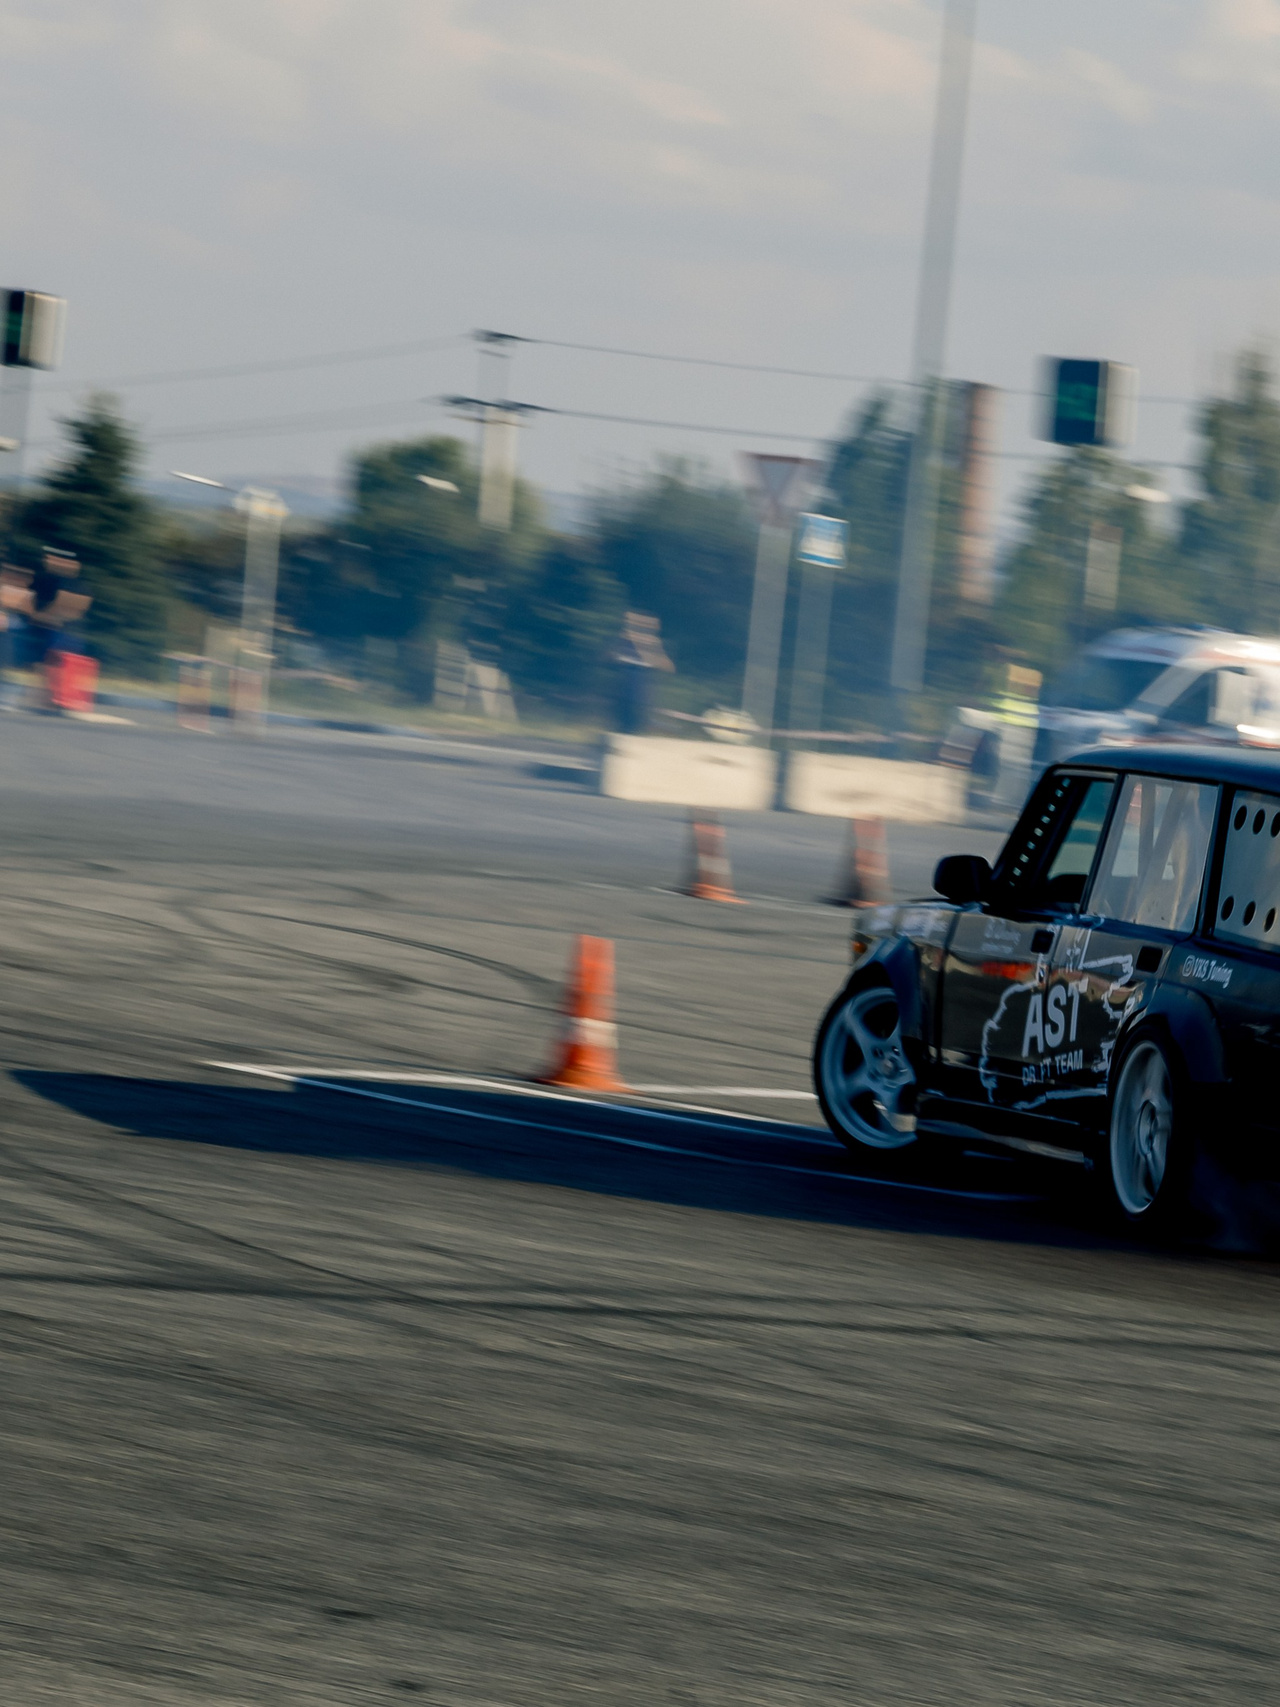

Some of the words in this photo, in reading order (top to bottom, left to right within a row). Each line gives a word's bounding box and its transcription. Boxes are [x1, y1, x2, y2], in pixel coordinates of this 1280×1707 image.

[1022, 977, 1089, 1058] AST
[1021, 1058, 1052, 1087] DRFT
[1055, 1049, 1084, 1075] TEAM
